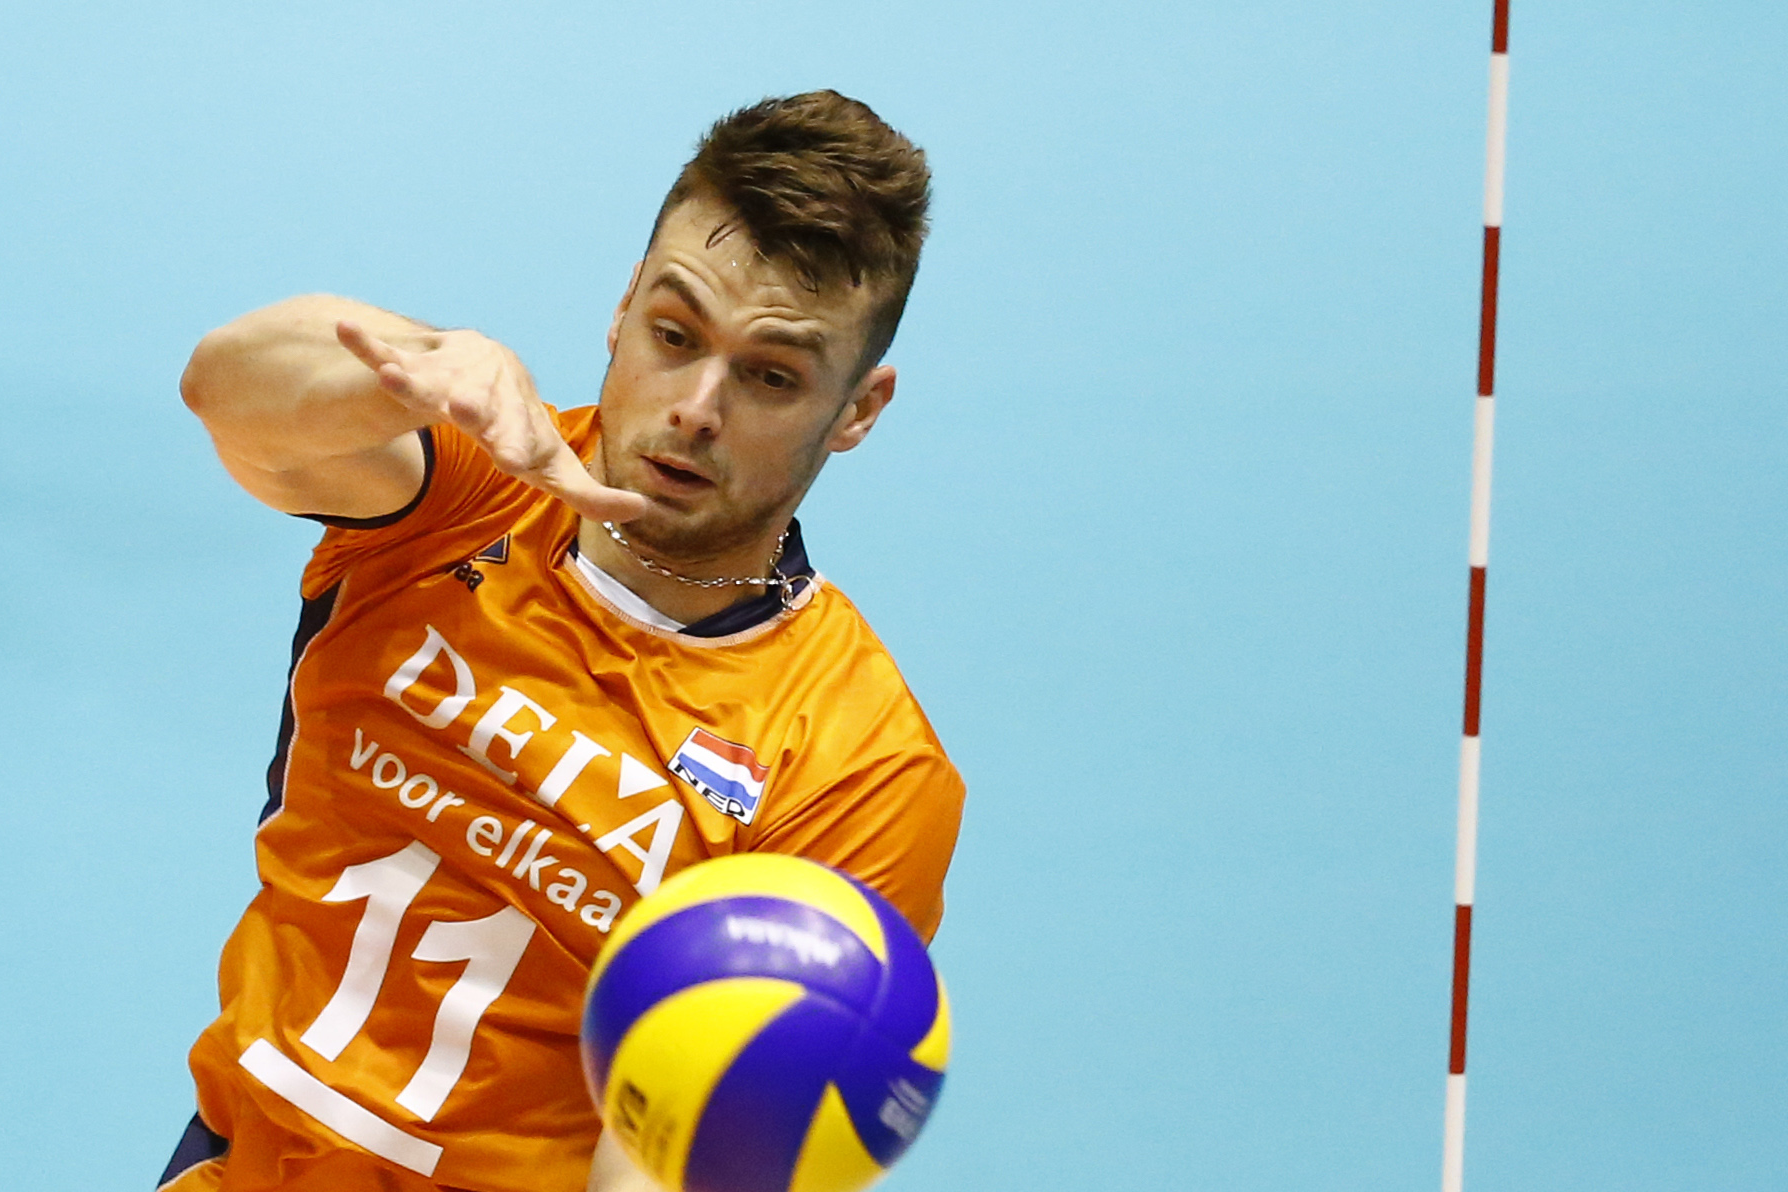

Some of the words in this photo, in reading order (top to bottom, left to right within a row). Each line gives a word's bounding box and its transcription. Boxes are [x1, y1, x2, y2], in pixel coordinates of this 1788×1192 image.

[349, 727, 465, 823] voor
[465, 818, 623, 934] elkaa
[383, 623, 685, 898] DELA
[674, 763, 745, 817] NED
[299, 839, 538, 1123] 11
